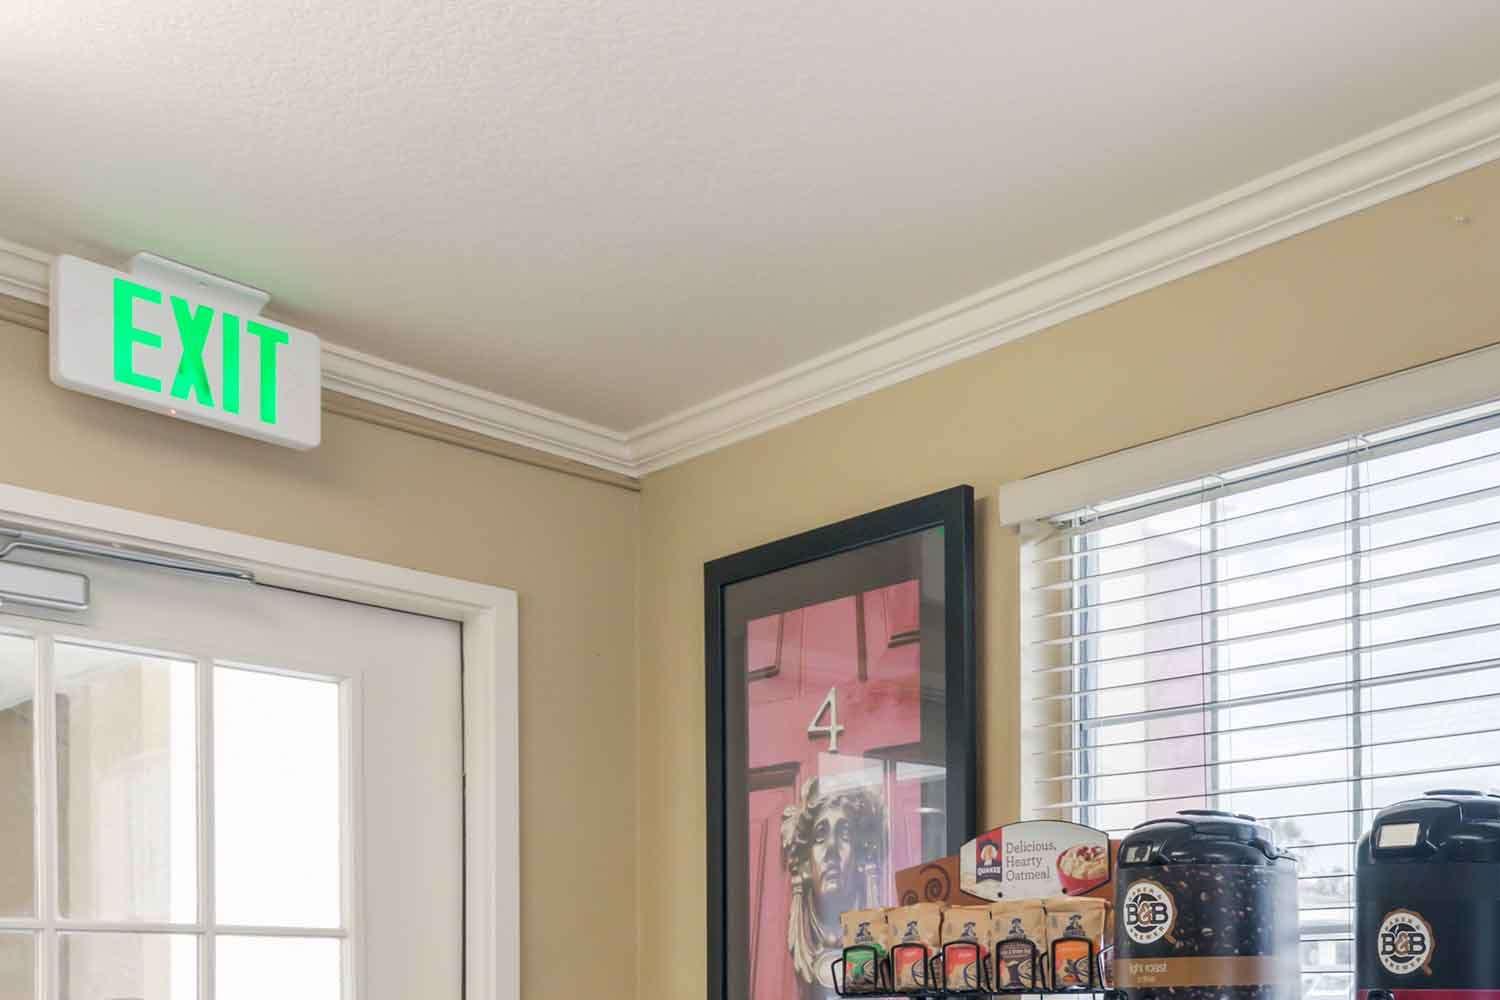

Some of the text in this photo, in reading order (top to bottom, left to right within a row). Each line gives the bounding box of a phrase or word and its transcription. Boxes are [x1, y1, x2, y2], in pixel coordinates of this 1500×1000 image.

[113, 277, 289, 425] EXIT
[808, 687, 844, 751] 4
[1006, 840, 1056, 854] Delicious,
[1006, 856, 1042, 868] Hearty
[1006, 867, 1050, 881] Oatmeal
[1126, 902, 1169, 925] B&B
[1381, 933, 1426, 955] B&B
